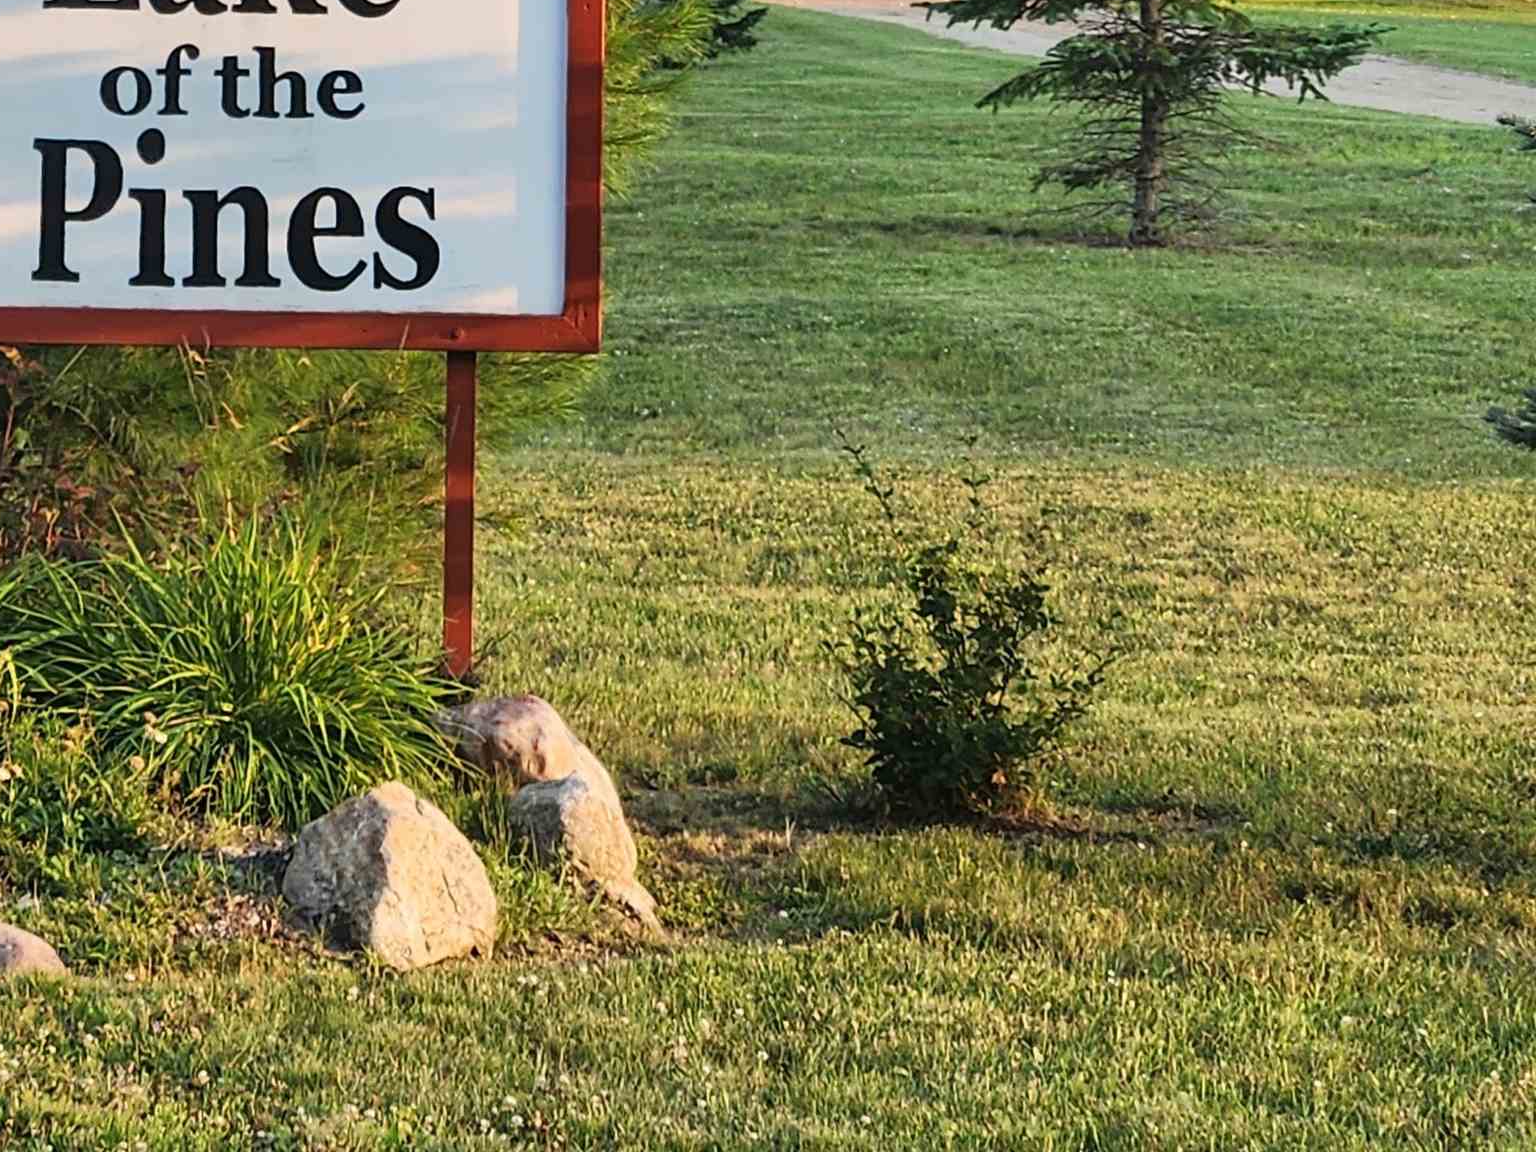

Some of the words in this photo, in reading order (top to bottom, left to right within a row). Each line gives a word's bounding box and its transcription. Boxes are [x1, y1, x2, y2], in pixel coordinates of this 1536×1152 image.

[98, 43, 200, 117] of
[212, 46, 366, 121] the
[30, 127, 441, 292] Pines
